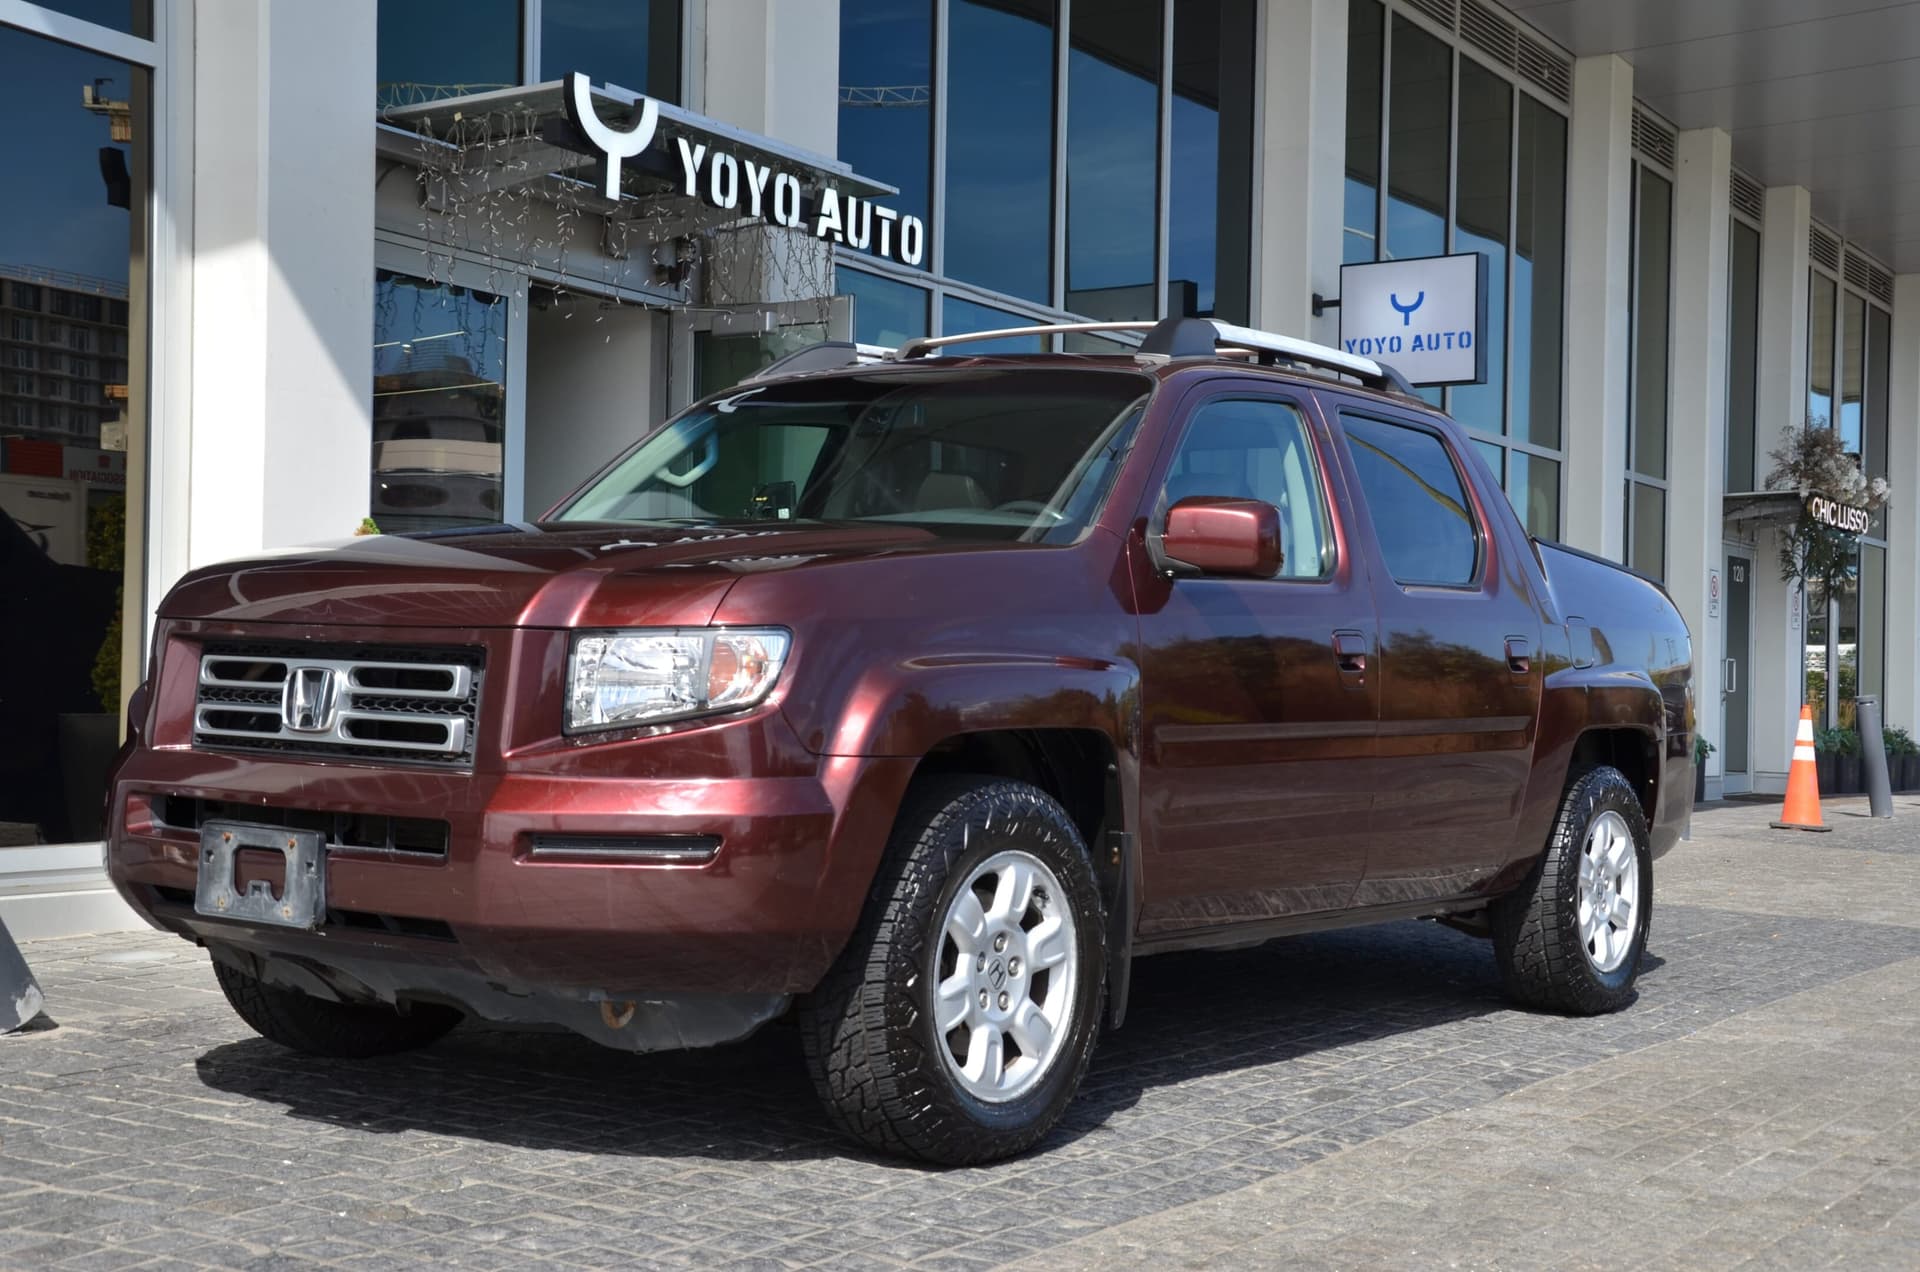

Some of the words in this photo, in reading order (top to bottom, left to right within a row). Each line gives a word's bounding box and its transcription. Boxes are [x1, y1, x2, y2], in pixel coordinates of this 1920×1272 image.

[676, 136, 800, 228] YOYO
[816, 187, 924, 266] AUTO
[1344, 335, 1402, 356] YOYO
[1411, 330, 1473, 353] AUTO
[1812, 496, 1837, 526] CHIC
[1837, 503, 1869, 534] LUSSO
[1732, 565, 1745, 583] 120
